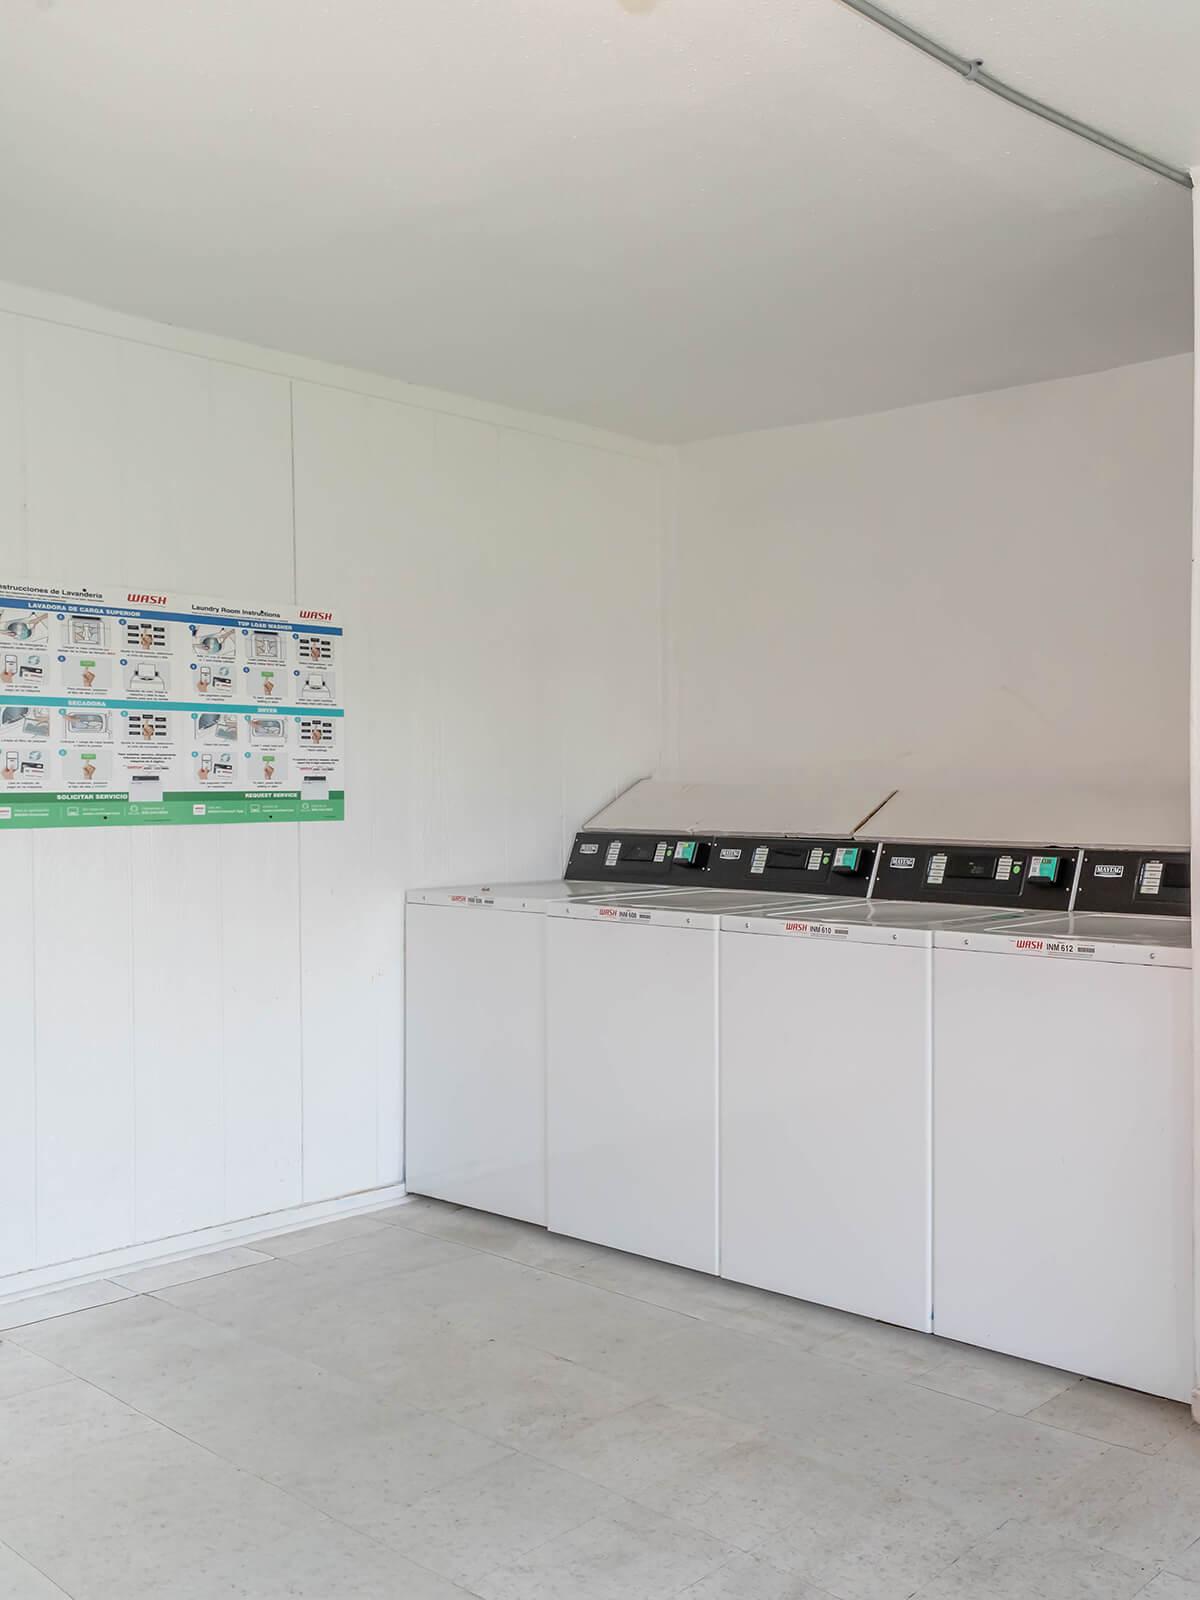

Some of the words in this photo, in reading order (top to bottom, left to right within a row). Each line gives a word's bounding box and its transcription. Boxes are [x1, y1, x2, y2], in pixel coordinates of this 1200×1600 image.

[127, 593, 167, 605] WASH
[28, 602, 67, 611] LAVADORA
[80, 606, 104, 614] CARGA
[106, 609, 141, 617] SUPERIOR
[191, 604, 219, 613] Laundry
[242, 609, 280, 618] Instructions
[299, 610, 333, 621] WASH
[1016, 939, 1043, 950] WASH
[1047, 943, 1060, 951] INM
[1061, 944, 1074, 952] 612
